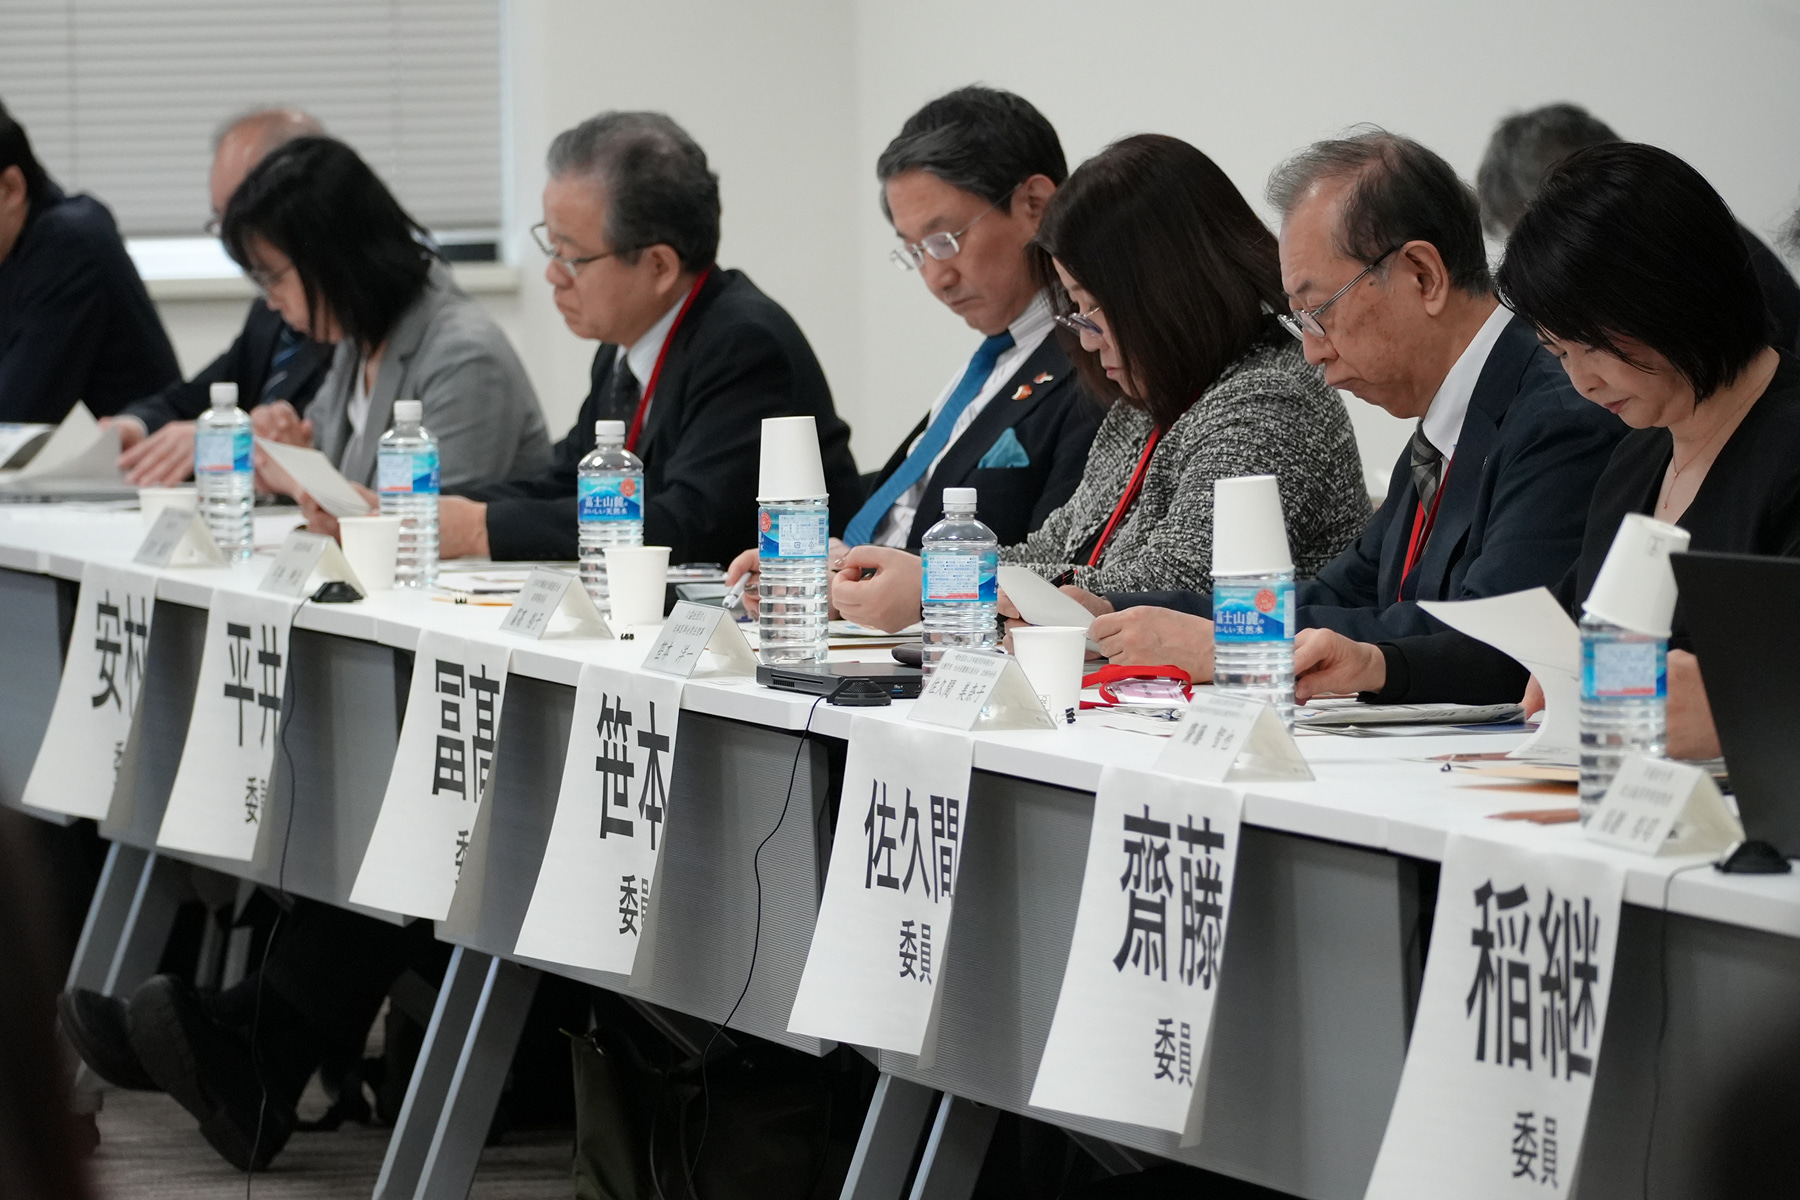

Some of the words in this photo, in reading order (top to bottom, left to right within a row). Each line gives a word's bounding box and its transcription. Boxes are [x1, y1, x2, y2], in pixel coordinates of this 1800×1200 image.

[224, 622, 282, 748] 平井
[595, 692, 670, 850] 笹本
[864, 778, 960, 904] 佐久間
[1113, 804, 1225, 991] 齋藤
[900, 919, 932, 986] 委員
[1466, 878, 1599, 1082] 稲継
[1154, 1018, 1193, 1088] 委員
[1512, 1110, 1558, 1190] 委員
